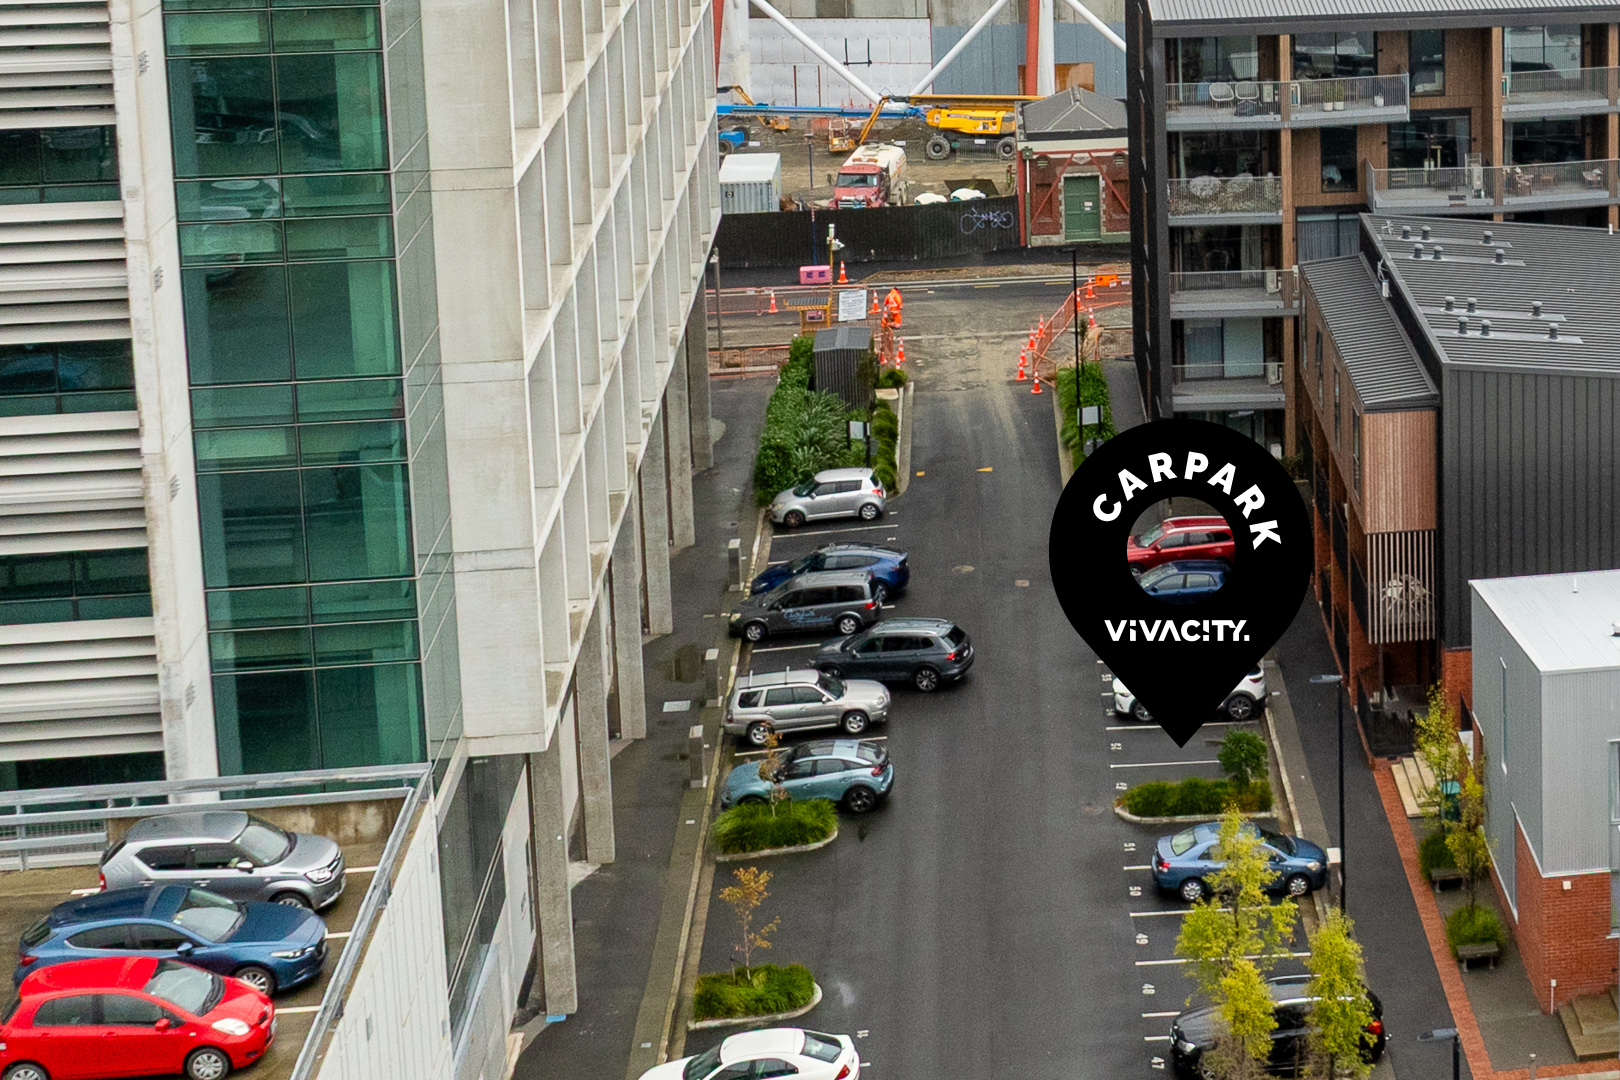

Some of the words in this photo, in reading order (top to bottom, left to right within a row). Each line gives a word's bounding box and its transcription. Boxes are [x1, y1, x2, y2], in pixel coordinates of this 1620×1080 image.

[1123, 842, 1136, 852] 51
[1128, 885, 1142, 897] 50
[1135, 933, 1149, 945] 49
[1142, 982, 1156, 995] 48
[1151, 1056, 1165, 1070] 47
